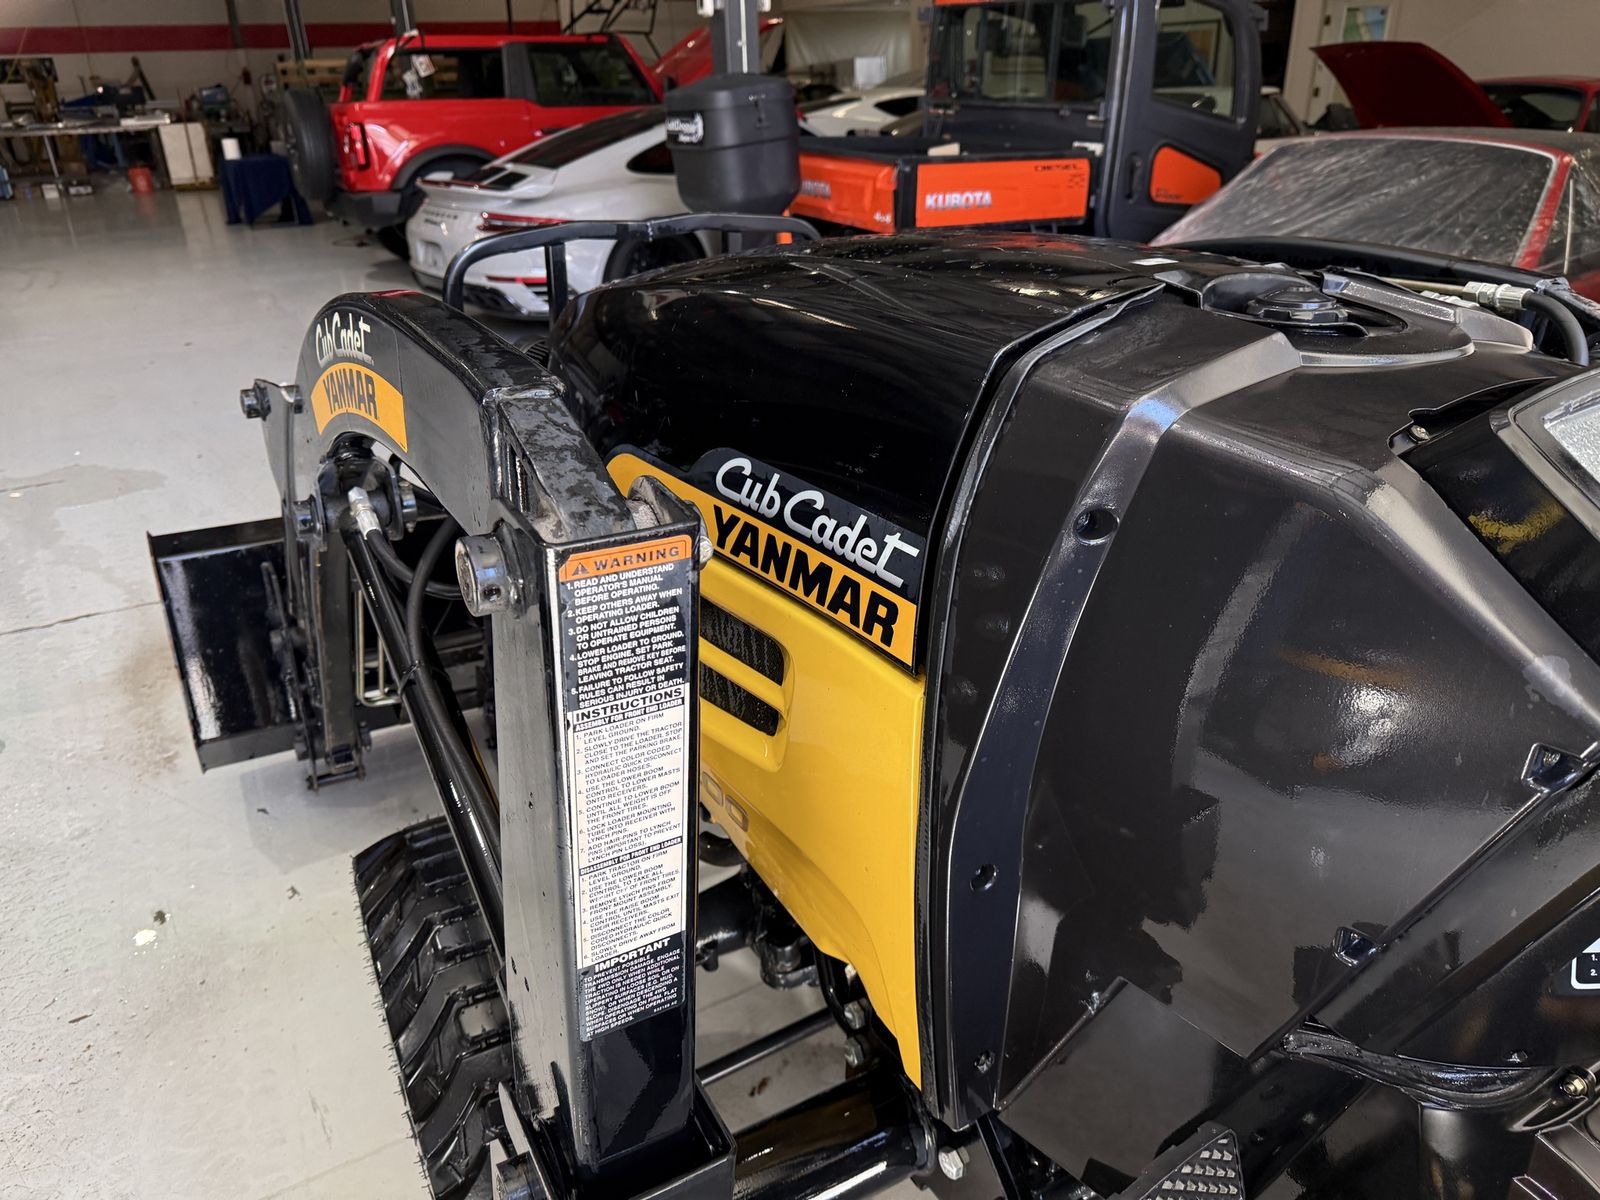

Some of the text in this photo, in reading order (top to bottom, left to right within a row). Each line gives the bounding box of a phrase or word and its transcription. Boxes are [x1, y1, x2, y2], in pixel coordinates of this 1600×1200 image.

[925, 191, 992, 210] KUBOTA
[315, 311, 373, 368] Cub Cadet
[322, 368, 378, 420] YANMAR
[715, 457, 920, 588] Cub Cadet
[594, 545, 679, 571] WARNING
[573, 577, 598, 588] READ
[599, 573, 618, 583] AND
[619, 563, 674, 580] UNDERSTAND
[574, 573, 663, 597] OPERATOR'S MANUAL
[713, 504, 899, 648] YANMAR
[574, 582, 659, 605] BEFORE OPERATING.
[575, 604, 598, 616] KEEP
[599, 597, 633, 610] OTHERS
[635, 592, 657, 603] AWAY
[658, 587, 682, 598] WHEN
[575, 600, 659, 624] OPERATING LOADER.
[576, 624, 589, 634] DO
[590, 620, 608, 630] NOT
[609, 614, 638, 626] ALLOW
[639, 606, 679, 620] CHILDREN
[576, 614, 676, 642] OR UNTRAINED PERSONS
[576, 622, 676, 650] TO OPERATE EQUIPMENT.
[576, 647, 605, 660] LOWER
[606, 640, 638, 653] LOADER
[639, 637, 649, 646] TO
[650, 630, 684, 643] GROUND.
[577, 656, 600, 668] STOP
[635, 645, 651, 654] SET
[652, 640, 673, 651] PARK
[577, 645, 685, 675] BRAKE AND REMOVE KEY BEFORE
[578, 655, 674, 683] LEAVING TRACTOR SEAT.
[578, 679, 610, 693] FAILURE
[612, 676, 622, 685] TO
[624, 669, 655, 682] FOLLOW
[656, 662, 683, 674] SAFETY
[579, 688, 606, 700] RULES
[607, 684, 624, 693] CAN
[626, 676, 655, 689] RESULT
[575, 687, 682, 722] INSTRUCTIONS
[579, 677, 684, 708] SERIOUS INJURY OR DEATH.
[575, 698, 682, 731] ASSEMBLY FOR FRONT END LOADER
[584, 728, 603, 738] PARK
[605, 720, 634, 732] LOADER
[647, 712, 664, 721] FIRM
[584, 725, 640, 744] LEVEL GROUND.
[584, 740, 613, 752] SLOWLY
[614, 734, 634, 744] DRIVE
[636, 730, 650, 738] THE
[652, 721, 682, 734] TRACTOR
[584, 747, 608, 759] CLOSE
[621, 740, 633, 749] THE
[665, 727, 682, 737] STOP
[584, 758, 619, 773] CONNECT
[620, 751, 645, 762] COLOR
[646, 744, 670, 755] CODED
[585, 756, 599, 765] AND
[600, 752, 612, 760] SET
[615, 748, 628, 756] THE
[629, 740, 658, 753] PARKING
[585, 747, 682, 779] HYDRAULIC QUICK DISCONNECT
[585, 784, 600, 793] USE
[602, 780, 615, 788] THE
[617, 772, 642, 783] LOWER
[643, 766, 663, 776] BOOM
[586, 784, 620, 799] CONTROL
[632, 774, 656, 785] LOWER
[658, 767, 680, 778] MASTS
[596, 769, 625, 782] LOADER
[626, 762, 652, 773] HOSES.
[586, 782, 648, 805] ONTO RECEIVERS.
[586, 797, 622, 812] CONTINUE
[634, 786, 658, 798] LOWER
[660, 780, 679, 790] BOOM
[586, 808, 606, 818] UNTIL
[608, 804, 621, 812] ALL
[623, 795, 650, 807] WEIGHT
[658, 789, 671, 797] OFF
[587, 802, 648, 824] THE FRONT TIRES.
[588, 870, 606, 880] PARK
[608, 859, 640, 873] TRACTOR
[652, 850, 667, 858] FIRM
[588, 864, 641, 886] LEVEL GROUND.
[589, 883, 672, 916] FRONT MOUNT ASSEMBLY.
[593, 965, 620, 979] PREVENT
[621, 954, 650, 969] POSSIBLE
[594, 937, 670, 972] IMPORTANT
[584, 954, 680, 994] THE 4WD ONLY WHEN ADDITIONAL
